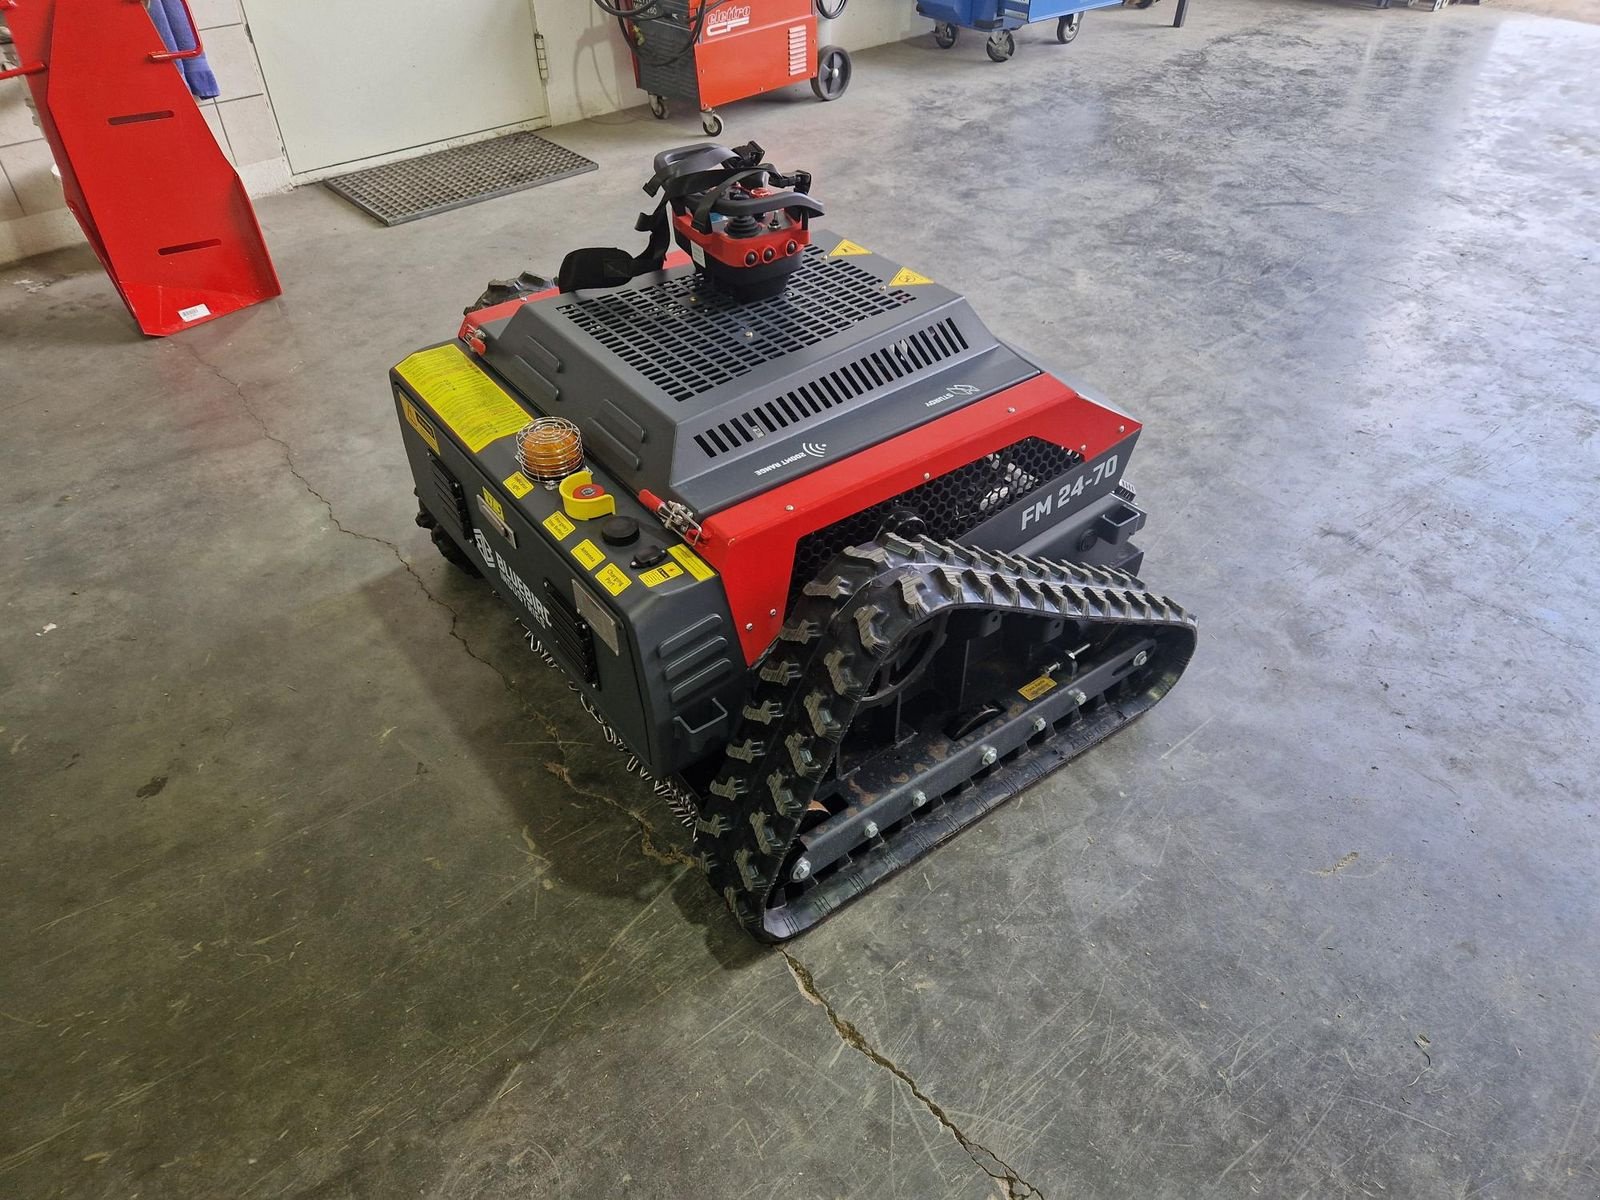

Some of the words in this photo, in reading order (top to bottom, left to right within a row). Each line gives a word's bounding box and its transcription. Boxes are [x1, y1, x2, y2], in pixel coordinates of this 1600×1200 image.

[707, 5, 751, 25] elettro
[924, 392, 955, 407] STURDY
[753, 461, 782, 476] RANGE
[1021, 494, 1053, 531] FM
[1057, 454, 1119, 509] 24-70
